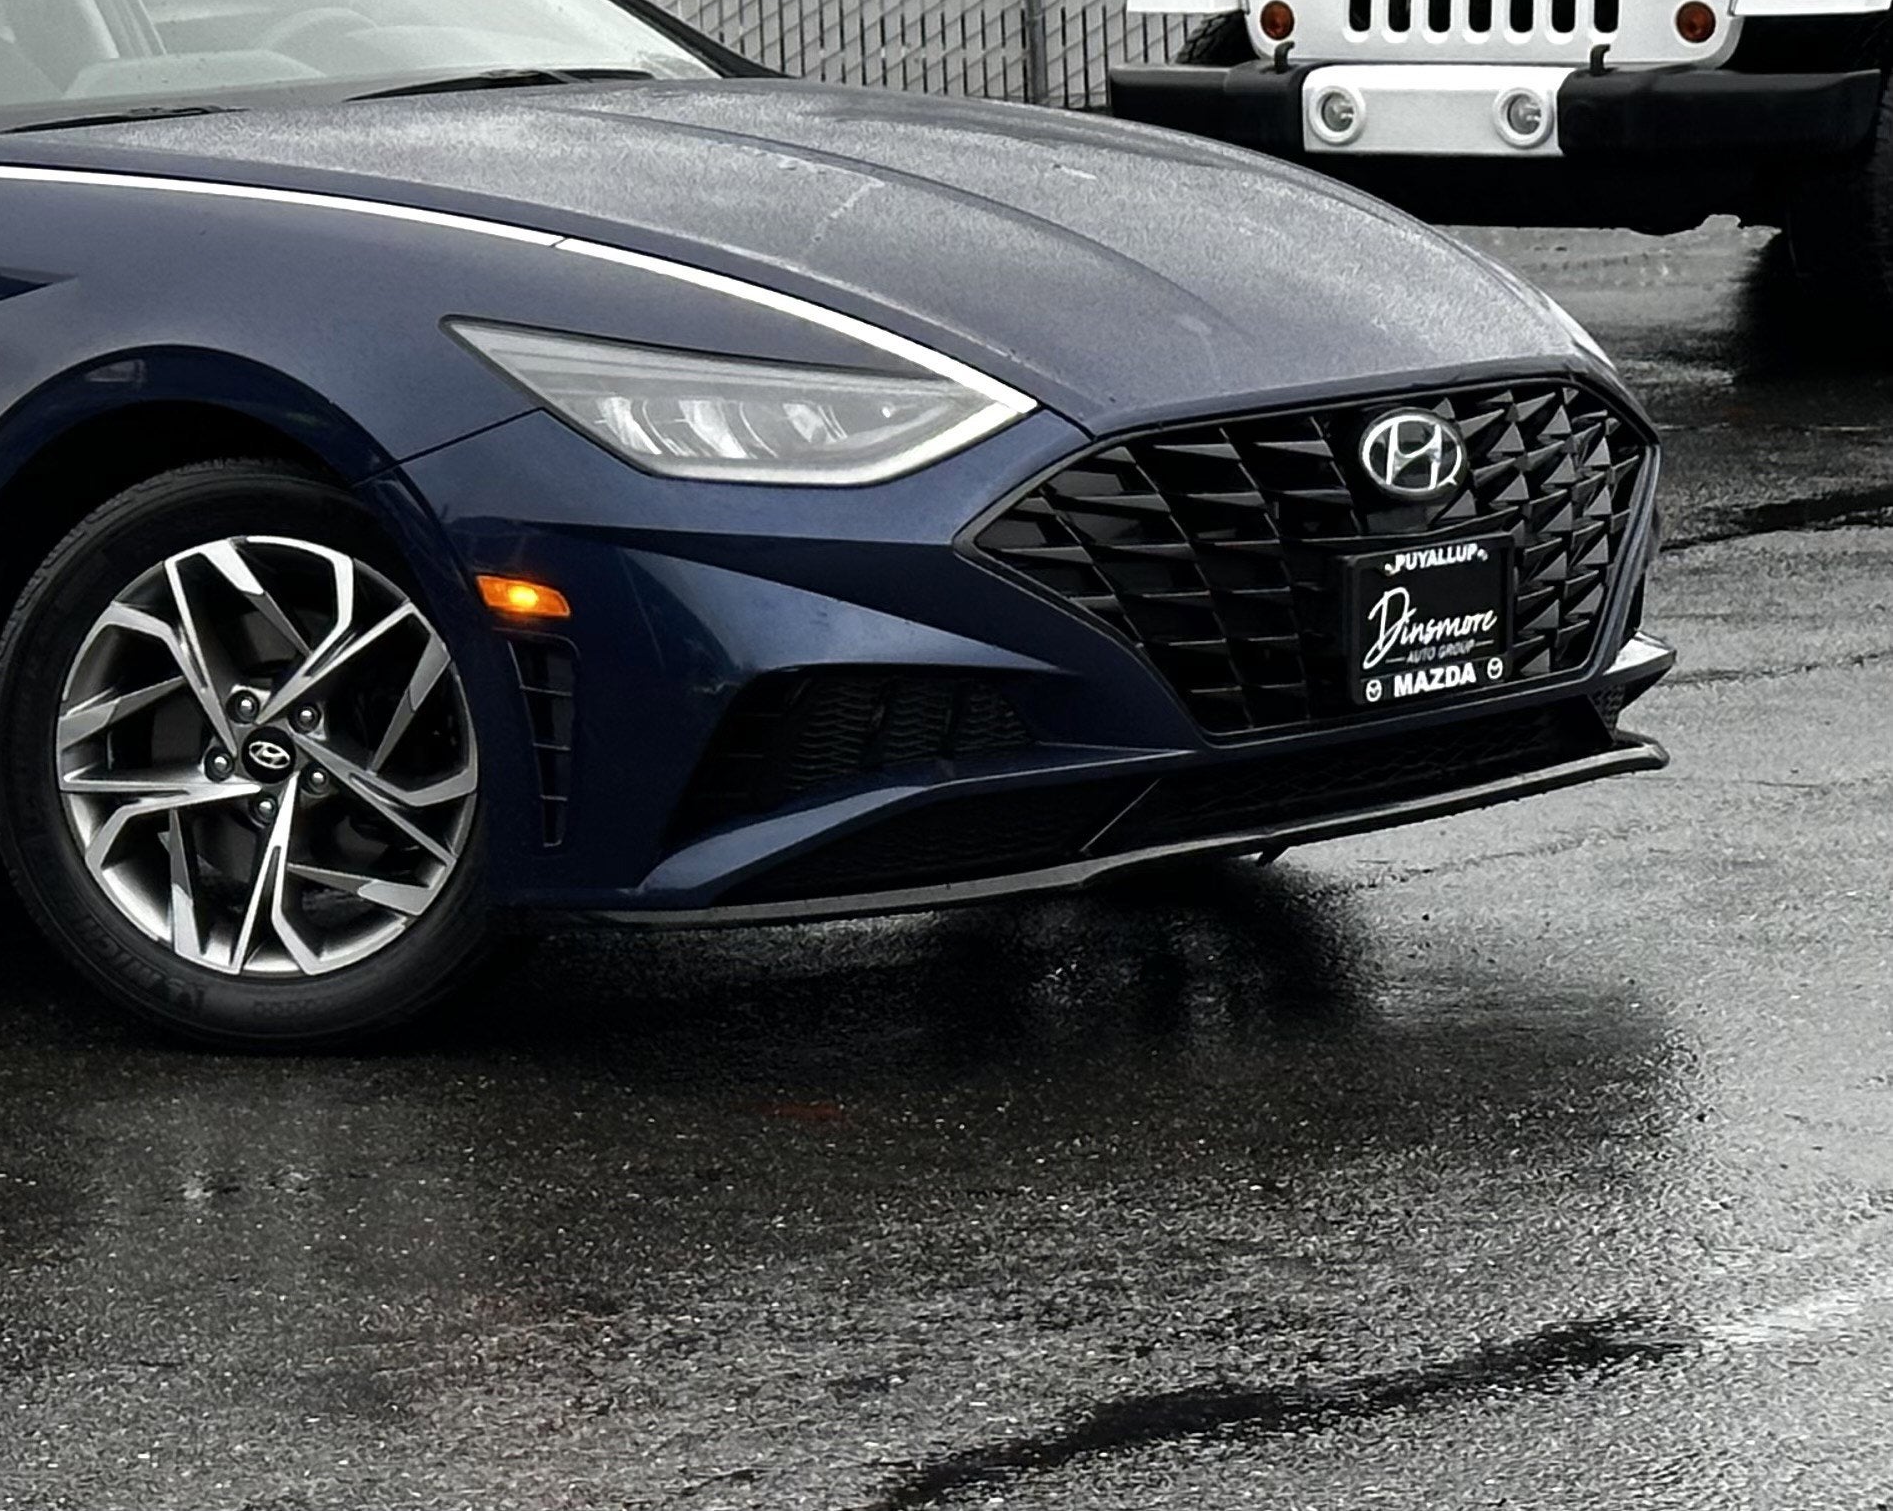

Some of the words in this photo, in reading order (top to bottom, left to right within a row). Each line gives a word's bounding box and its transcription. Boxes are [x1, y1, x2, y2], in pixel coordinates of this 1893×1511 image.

[1394, 543, 1478, 574] PUYALLUP
[1362, 586, 1498, 670] Dinsmore
[1407, 646, 1436, 664] AUTO
[1437, 639, 1476, 658] GROUP
[1393, 662, 1477, 698] MAZDA
